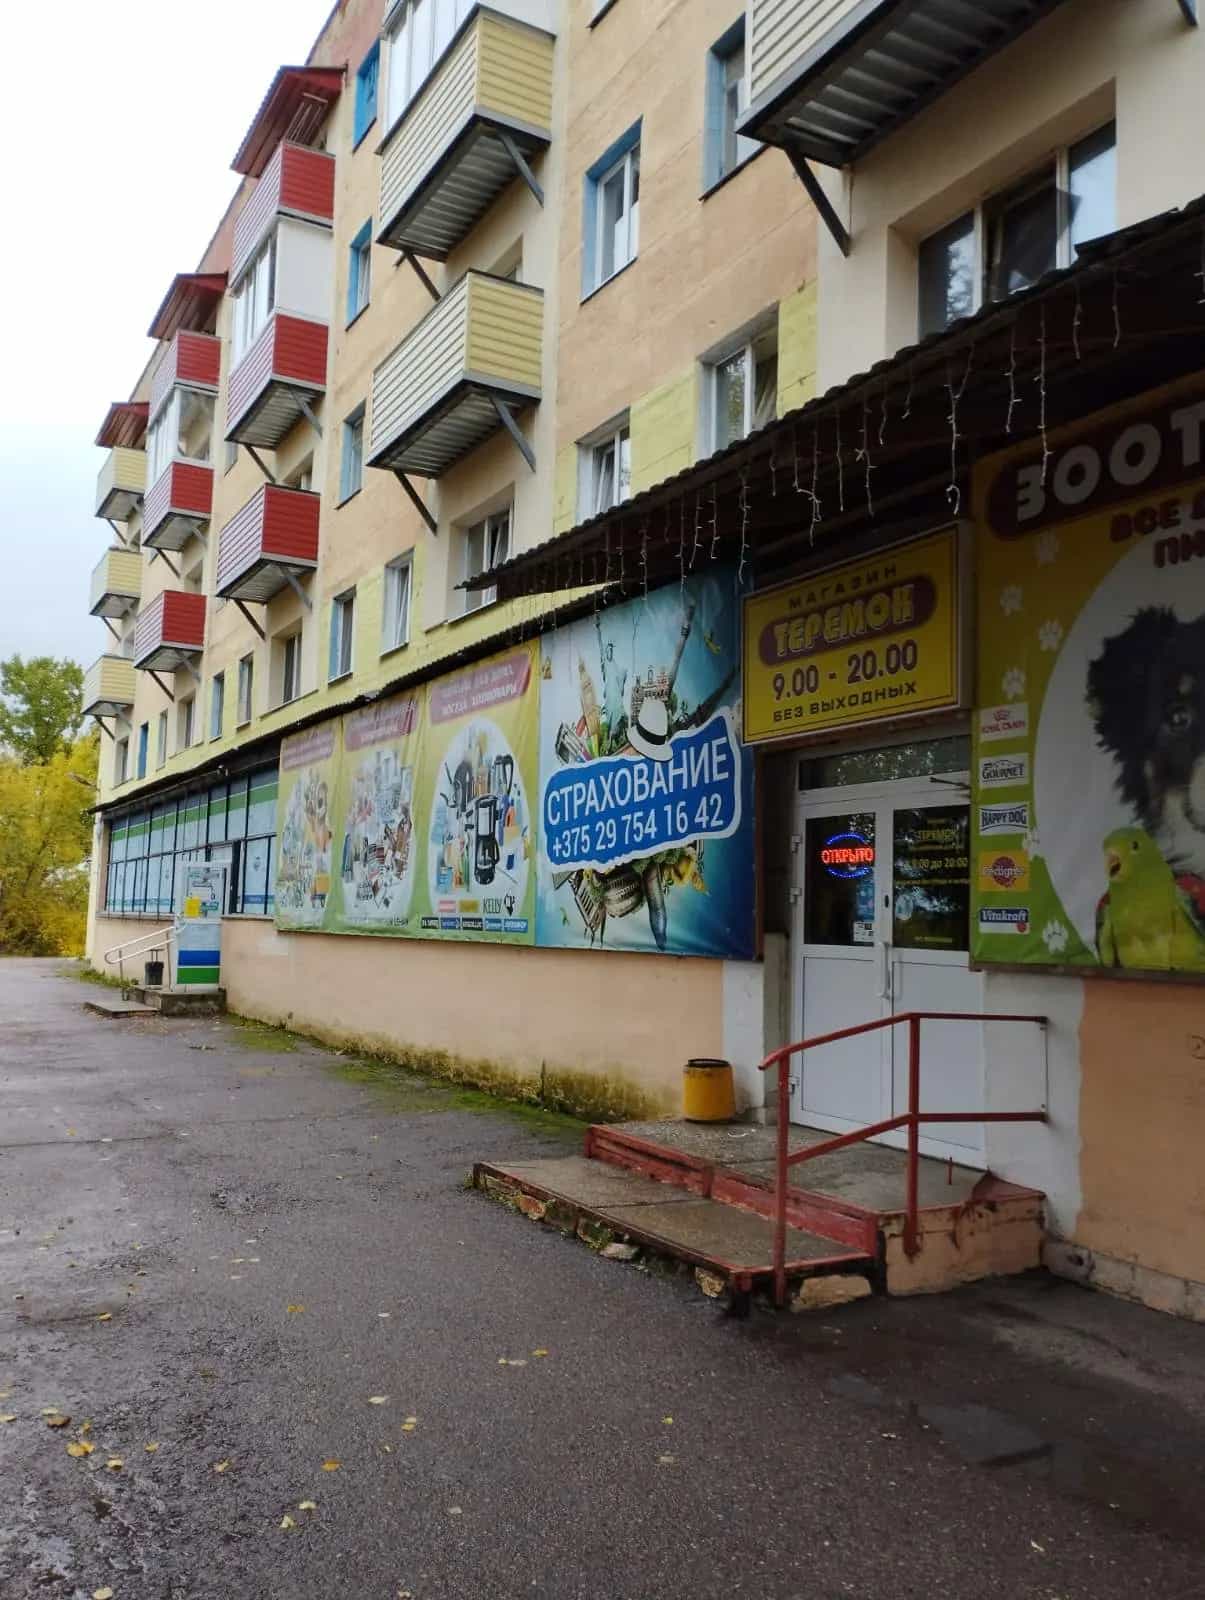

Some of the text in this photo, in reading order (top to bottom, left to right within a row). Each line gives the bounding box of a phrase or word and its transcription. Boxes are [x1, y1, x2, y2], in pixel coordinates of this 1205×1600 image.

[789, 565, 897, 610] МАГАЗИН
[774, 584, 914, 656] ТЕРЕМОК
[773, 664, 818, 701] 9.00
[847, 639, 918, 684] 20.00
[773, 681, 917, 723] БЕЗ ВЫХОДНЫХ
[547, 736, 729, 825] СТРАХОВАНИЕ
[553, 793, 724, 858] +375 29 754 16 42
[981, 808, 1027, 826] HAPPY DOG
[821, 847, 874, 864] ОТКРЫТО
